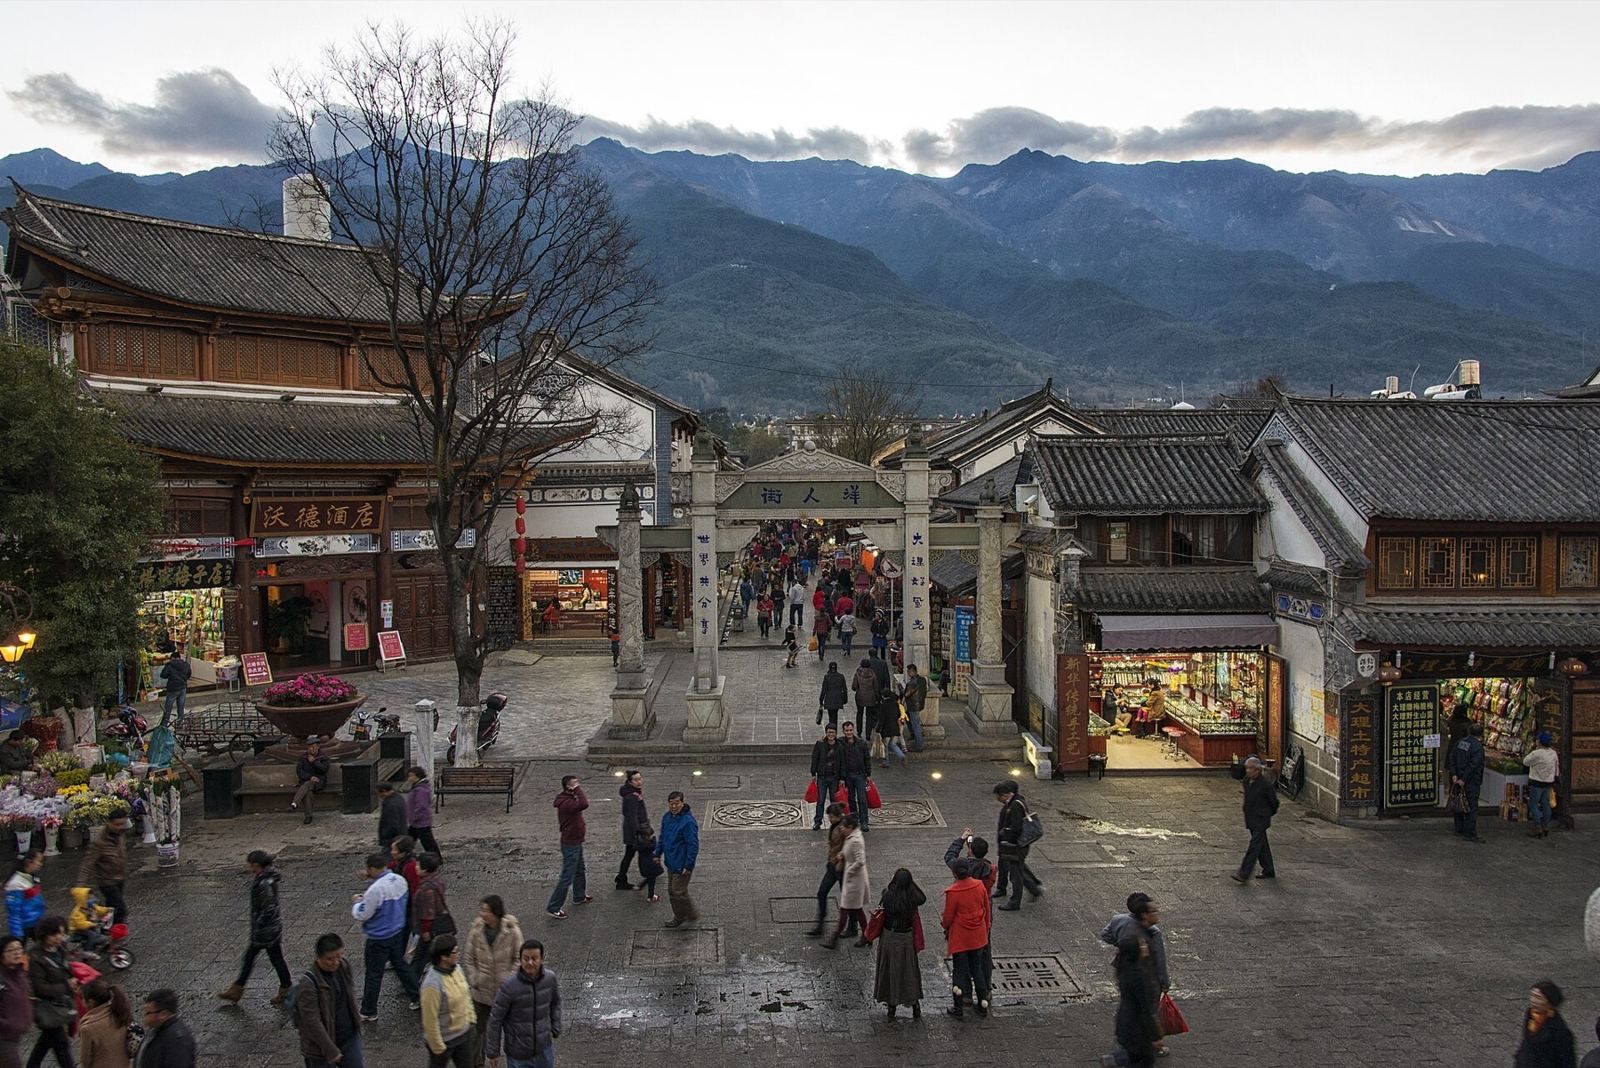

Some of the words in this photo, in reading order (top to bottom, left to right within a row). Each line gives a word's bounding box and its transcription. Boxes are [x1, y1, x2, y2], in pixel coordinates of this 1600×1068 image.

[761, 485, 860, 505] 洋人街
[263, 502, 374, 529] 沃德酒店
[1064, 657, 1081, 755] 新华传统手工艺
[1396, 690, 1430, 701] 本店经营
[1350, 702, 1372, 799] 大理土特产超市
